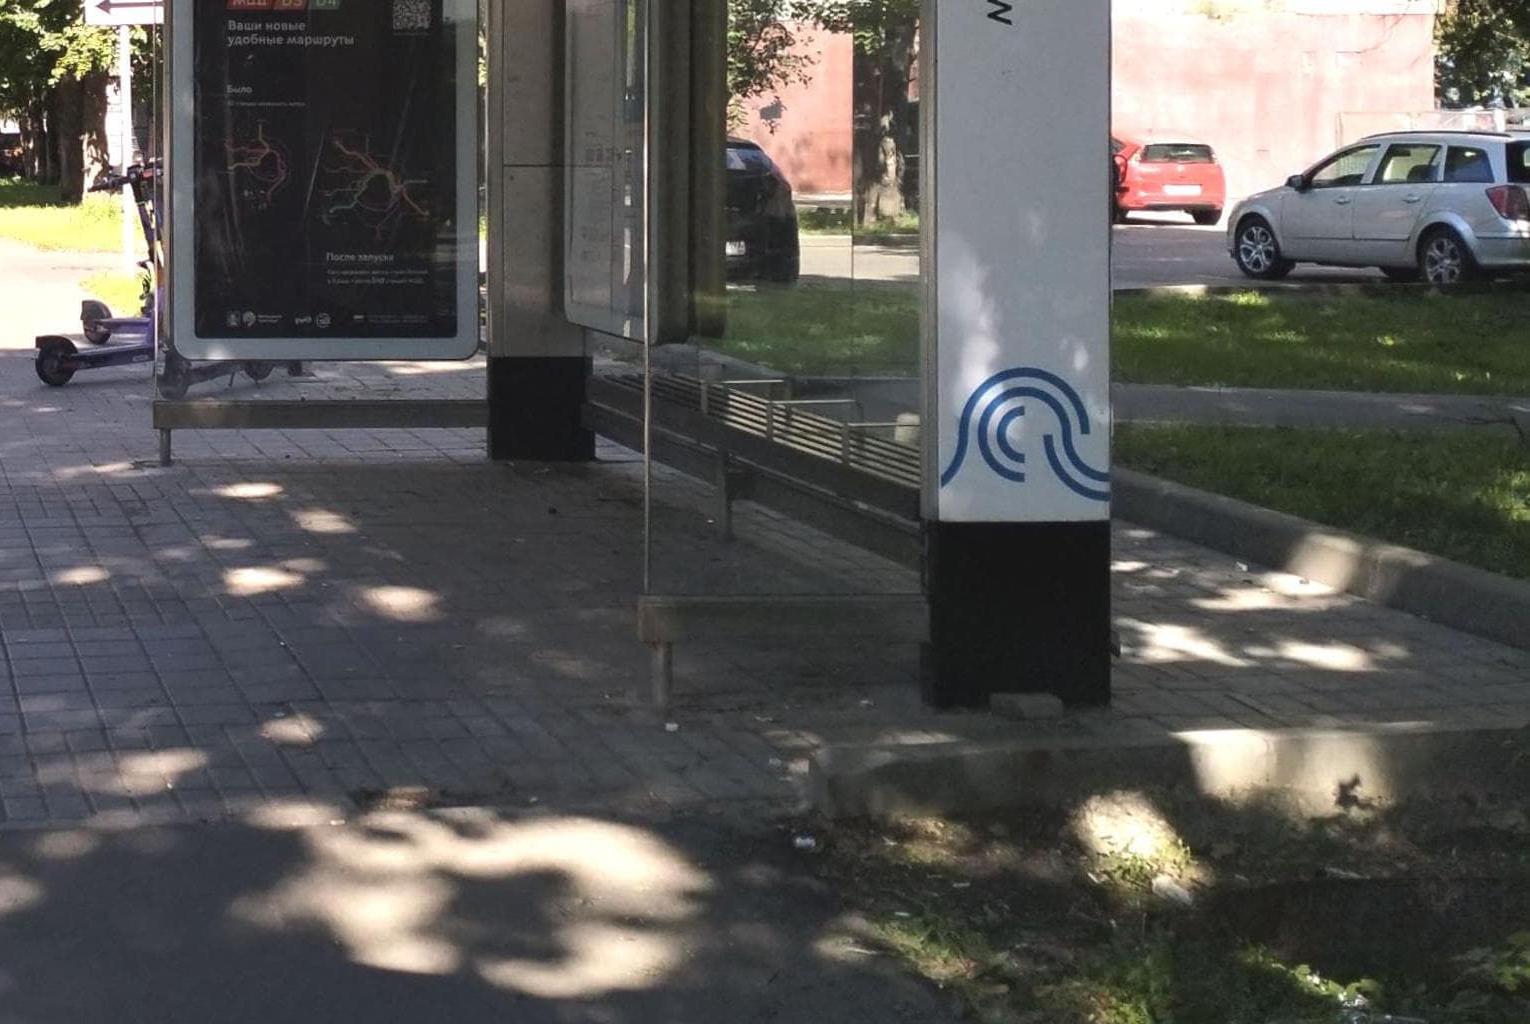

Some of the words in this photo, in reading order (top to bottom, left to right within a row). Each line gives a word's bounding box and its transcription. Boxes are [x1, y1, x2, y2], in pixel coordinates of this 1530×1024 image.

[228, 20, 262, 32] Ваши
[265, 22, 306, 32] новые
[226, 34, 283, 47] удобные
[287, 36, 355, 48] маршруты
